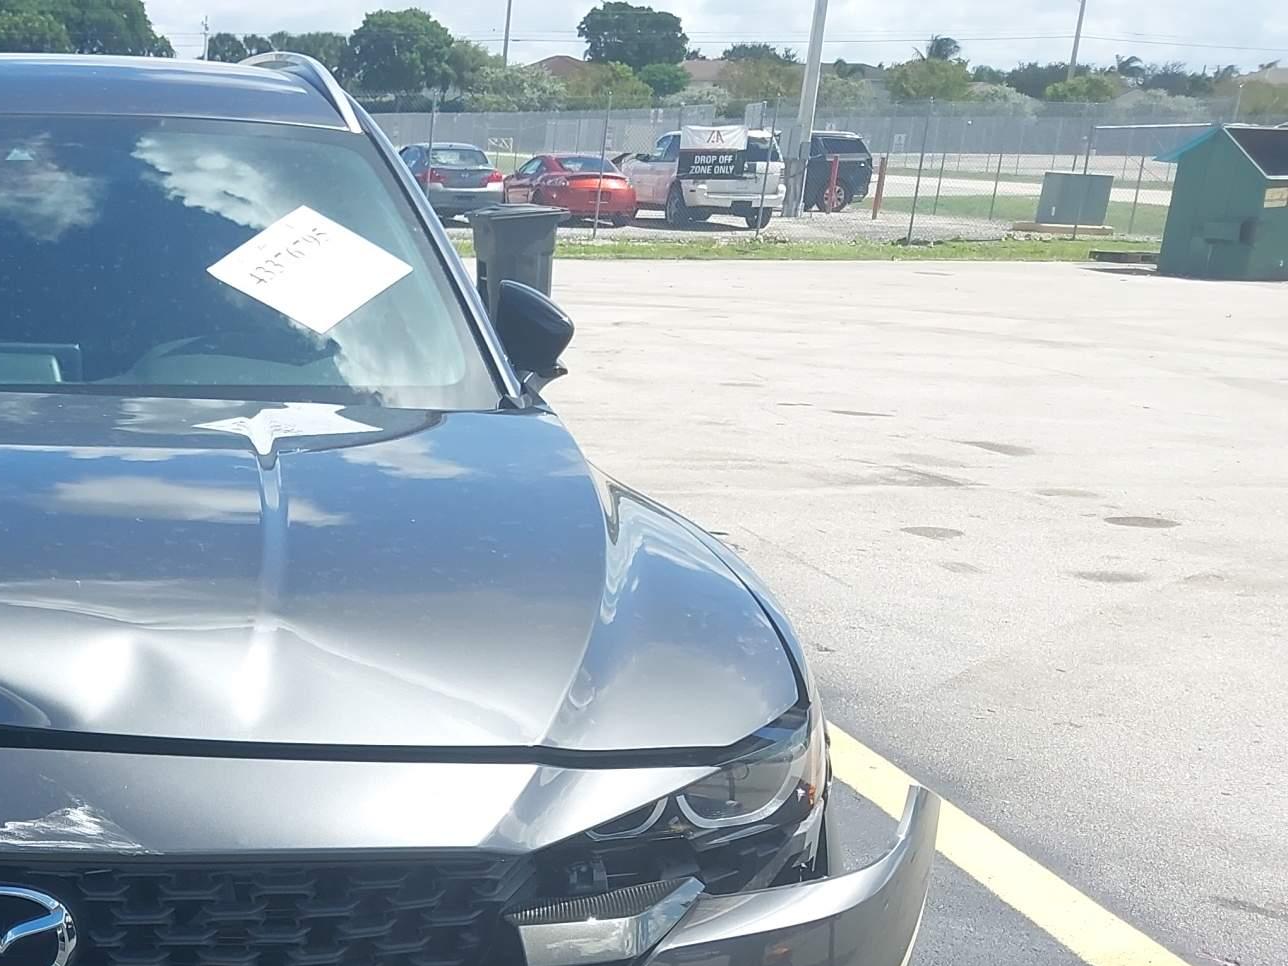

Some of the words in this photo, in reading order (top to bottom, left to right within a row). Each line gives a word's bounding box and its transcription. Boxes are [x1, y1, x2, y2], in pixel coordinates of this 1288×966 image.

[694, 155, 717, 164] DROP
[718, 154, 733, 164] OFF
[689, 165, 712, 174] ZONE
[713, 165, 734, 174] ONLY
